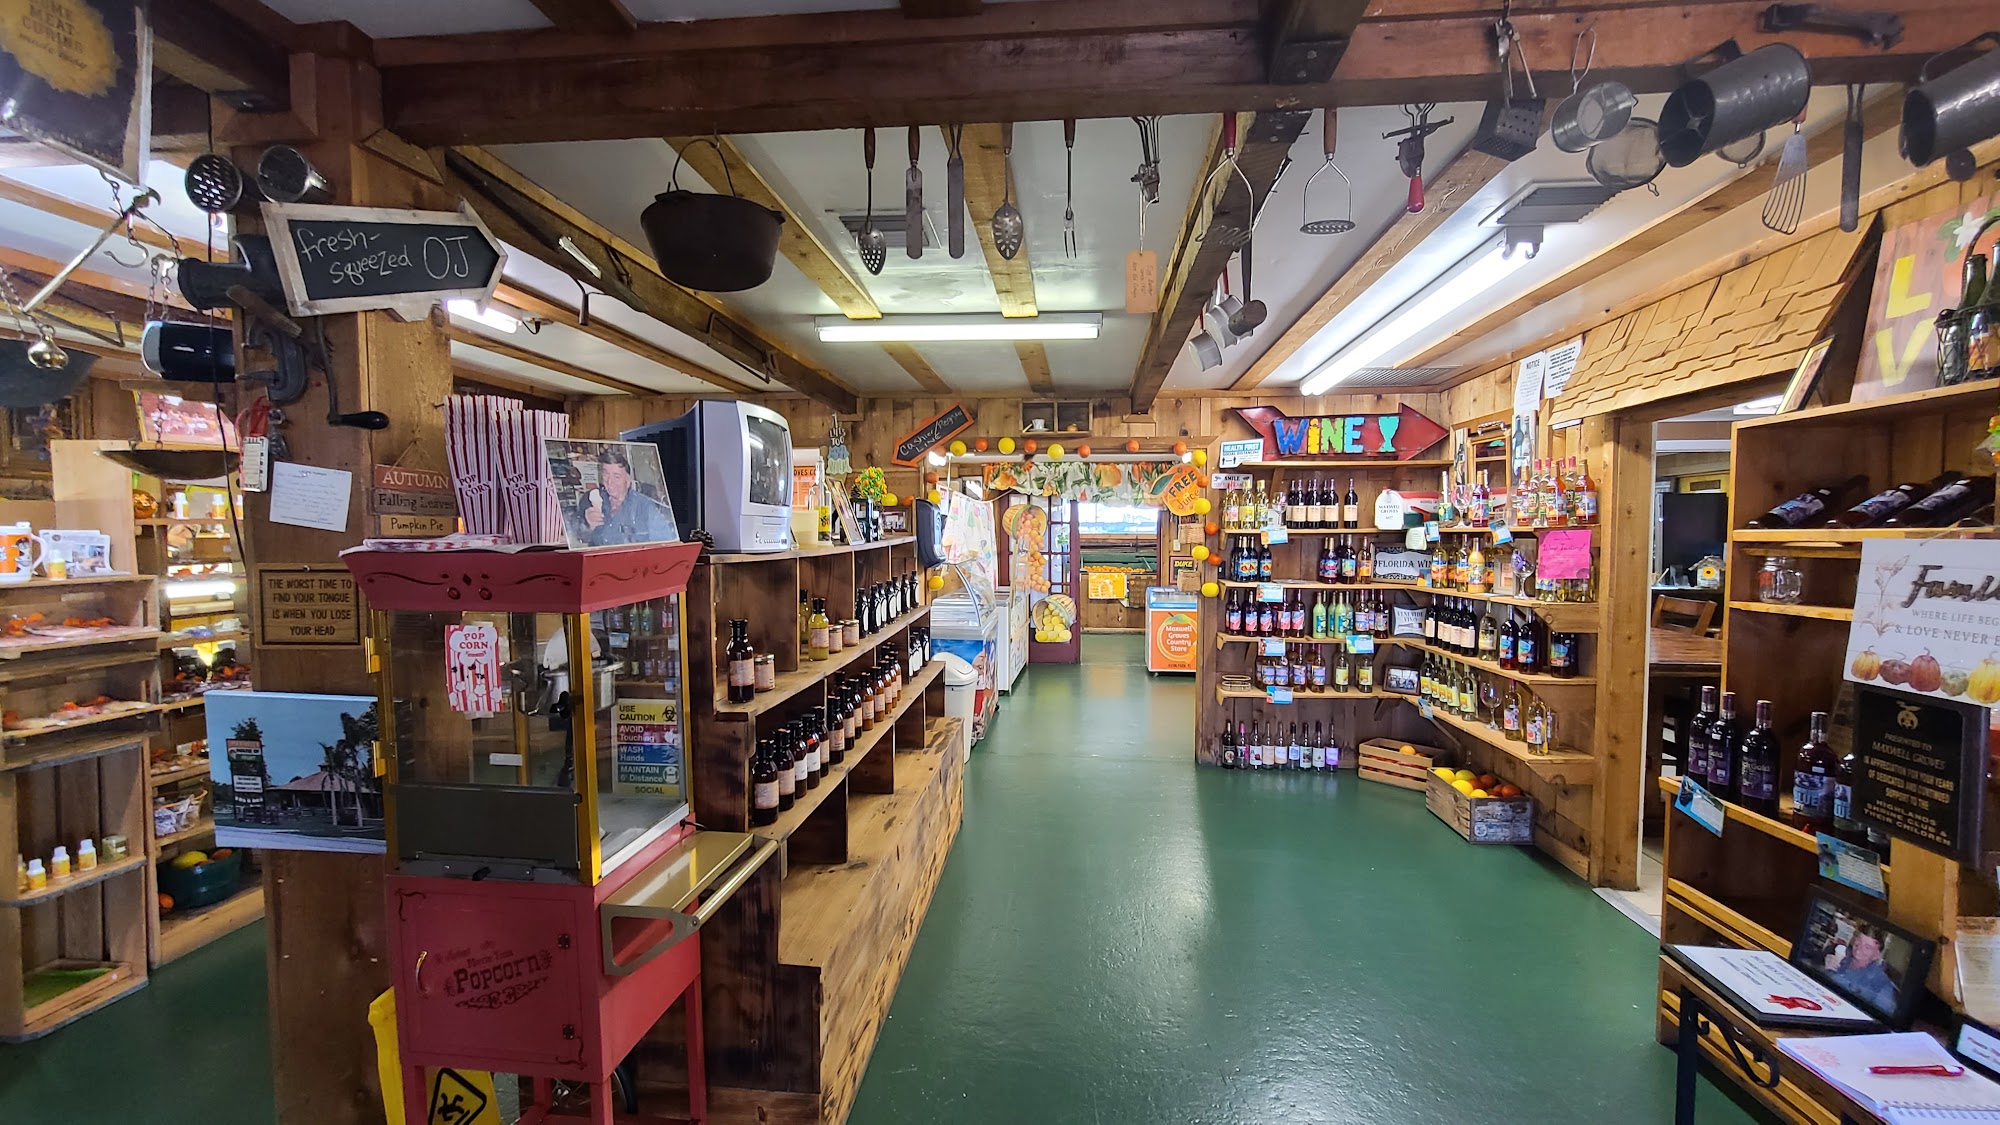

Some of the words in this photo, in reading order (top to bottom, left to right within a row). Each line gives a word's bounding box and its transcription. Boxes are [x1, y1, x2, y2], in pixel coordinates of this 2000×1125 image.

[297, 228, 380, 263] fresh-
[423, 235, 469, 279] OJ
[1526, 359, 1541, 370] NOTICE
[830, 436, 845, 446] TOO
[1223, 444, 1244, 452] HEALTH
[1244, 443, 1260, 451] FIRST
[382, 471, 450, 490] AUTUMN
[459, 474, 477, 486] POP
[506, 473, 524, 486] POP
[1168, 470, 1198, 498] FREE
[465, 482, 491, 497] CORN
[512, 481, 538, 498] CORN
[378, 493, 417, 511] Falling
[420, 497, 456, 510] Leaves
[391, 517, 427, 533] Pumpkin
[430, 518, 444, 531] Pie
[1174, 560, 1193, 568] DUKE
[1378, 560, 1415, 568] FLORIDA
[267, 579, 284, 589] THE
[287, 579, 315, 589] WORST
[318, 579, 337, 589] TIME
[342, 579, 352, 589] TO
[273, 593, 290, 602] FIND
[294, 593, 315, 602] YOUR
[318, 593, 350, 602] TONGUE
[272, 610, 280, 619] IS
[283, 610, 305, 619] WHEN
[311, 610, 327, 619] YOU
[330, 610, 351, 619] LOSE
[1912, 609, 1947, 621] WHERE
[1951, 613, 1973, 624] LIFE
[289, 626, 312, 636] YOUR
[314, 626, 335, 635] HEAD
[464, 632, 485, 640] POP
[1168, 632, 1190, 640] Groves
[1894, 624, 1902, 633] &
[1906, 625, 1939, 638] LOVE
[1943, 629, 1988, 645] NEVER
[459, 641, 489, 649] CORN
[1166, 639, 1192, 647] Country
[619, 705, 636, 713] USE
[619, 713, 656, 722] CAUTION
[619, 725, 644, 733] AVOID
[620, 733, 655, 743] Touching
[1884, 732, 1920, 749] PRESENTED
[1921, 742, 1932, 752] TO
[620, 754, 645, 762] Hands
[1872, 741, 1910, 760] MAXWELL
[1912, 753, 1946, 770] GROVES
[620, 766, 660, 774] MAINTAIN
[629, 774, 663, 782] Distance
[634, 786, 665, 794] SOCIAL
[1866, 802, 1904, 821] SHRINE
[1907, 818, 1936, 833] CLUB
[1876, 799, 1937, 826] HIGHLANDS
[1863, 808, 1893, 824] THEIR
[1895, 821, 1951, 847] CHILDREN
[453, 955, 541, 994] Popcorn
